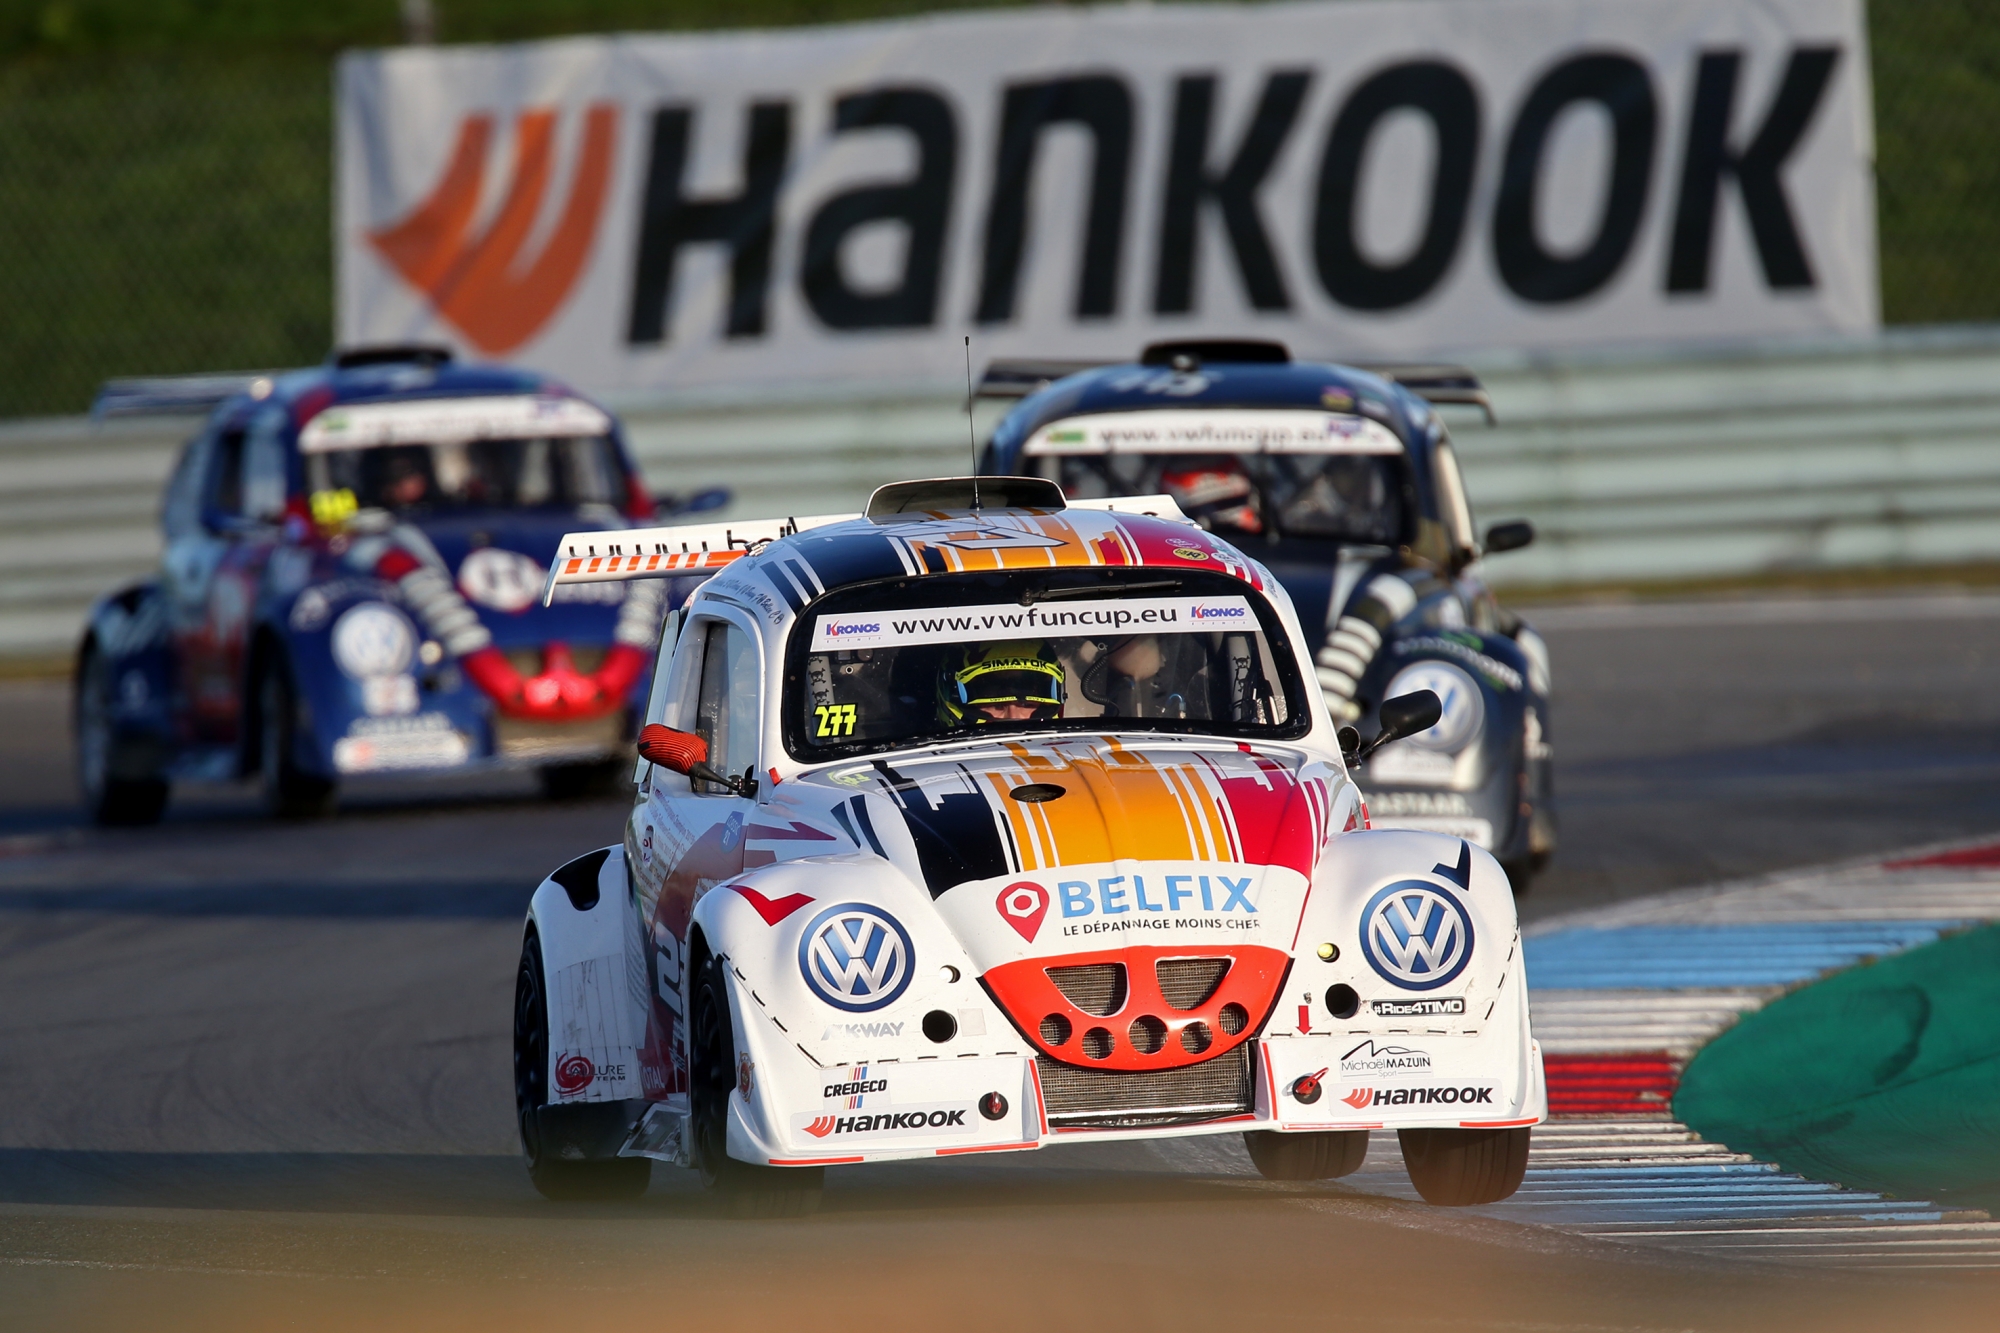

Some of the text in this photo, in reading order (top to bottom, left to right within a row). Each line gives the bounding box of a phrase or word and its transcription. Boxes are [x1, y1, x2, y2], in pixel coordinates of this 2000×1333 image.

[1191, 602, 1245, 619] KRONOS
[826, 619, 880, 636] KRONOS
[892, 607, 1178, 635] www.vwfuncup.eu
[981, 658, 1048, 670] SIMATOK
[814, 704, 857, 737] 277
[1057, 875, 1259, 919] BELFIX
[1063, 925, 1079, 936] LE
[1083, 918, 1170, 935] DÉPANNAGE
[1175, 918, 1222, 930] MOINS
[1386, 1057, 1431, 1068] MAZUIN
[823, 1079, 888, 1098] CREDECO
